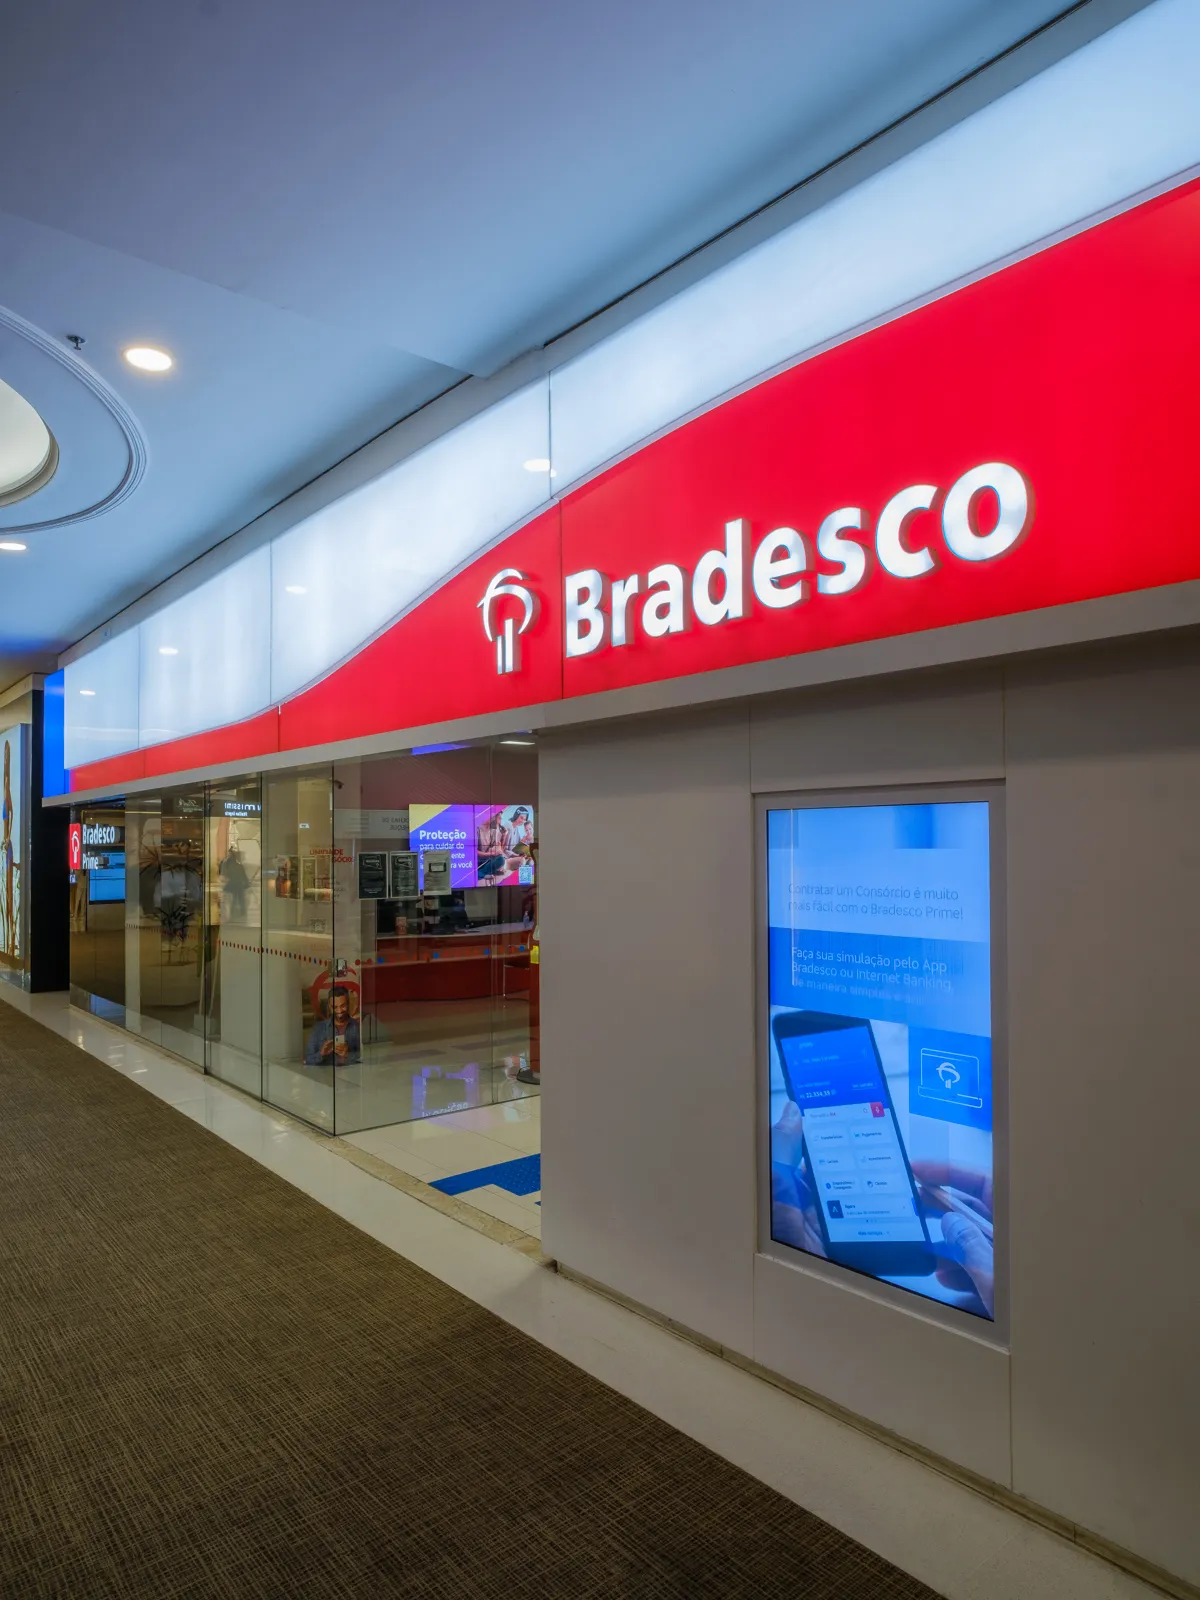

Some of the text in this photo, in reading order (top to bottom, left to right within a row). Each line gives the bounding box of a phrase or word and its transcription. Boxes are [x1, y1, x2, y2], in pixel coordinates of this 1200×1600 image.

[565, 462, 1029, 658] Bradesco
[82, 823, 115, 845] Bradesco
[419, 829, 467, 842] Proteção
[419, 842, 465, 851] para cuidar do
[82, 853, 99, 869] Prime
[458, 860, 473, 869] você
[788, 883, 959, 900] Contratar um Consórcio é muito
[788, 900, 964, 920] mais fácil com o Bradesco Prime!
[791, 947, 947, 975] Faça sua simulação pelo App
[792, 961, 838, 976] Bradesco
[840, 968, 854, 978] ou
[856, 969, 900, 984] Internet
